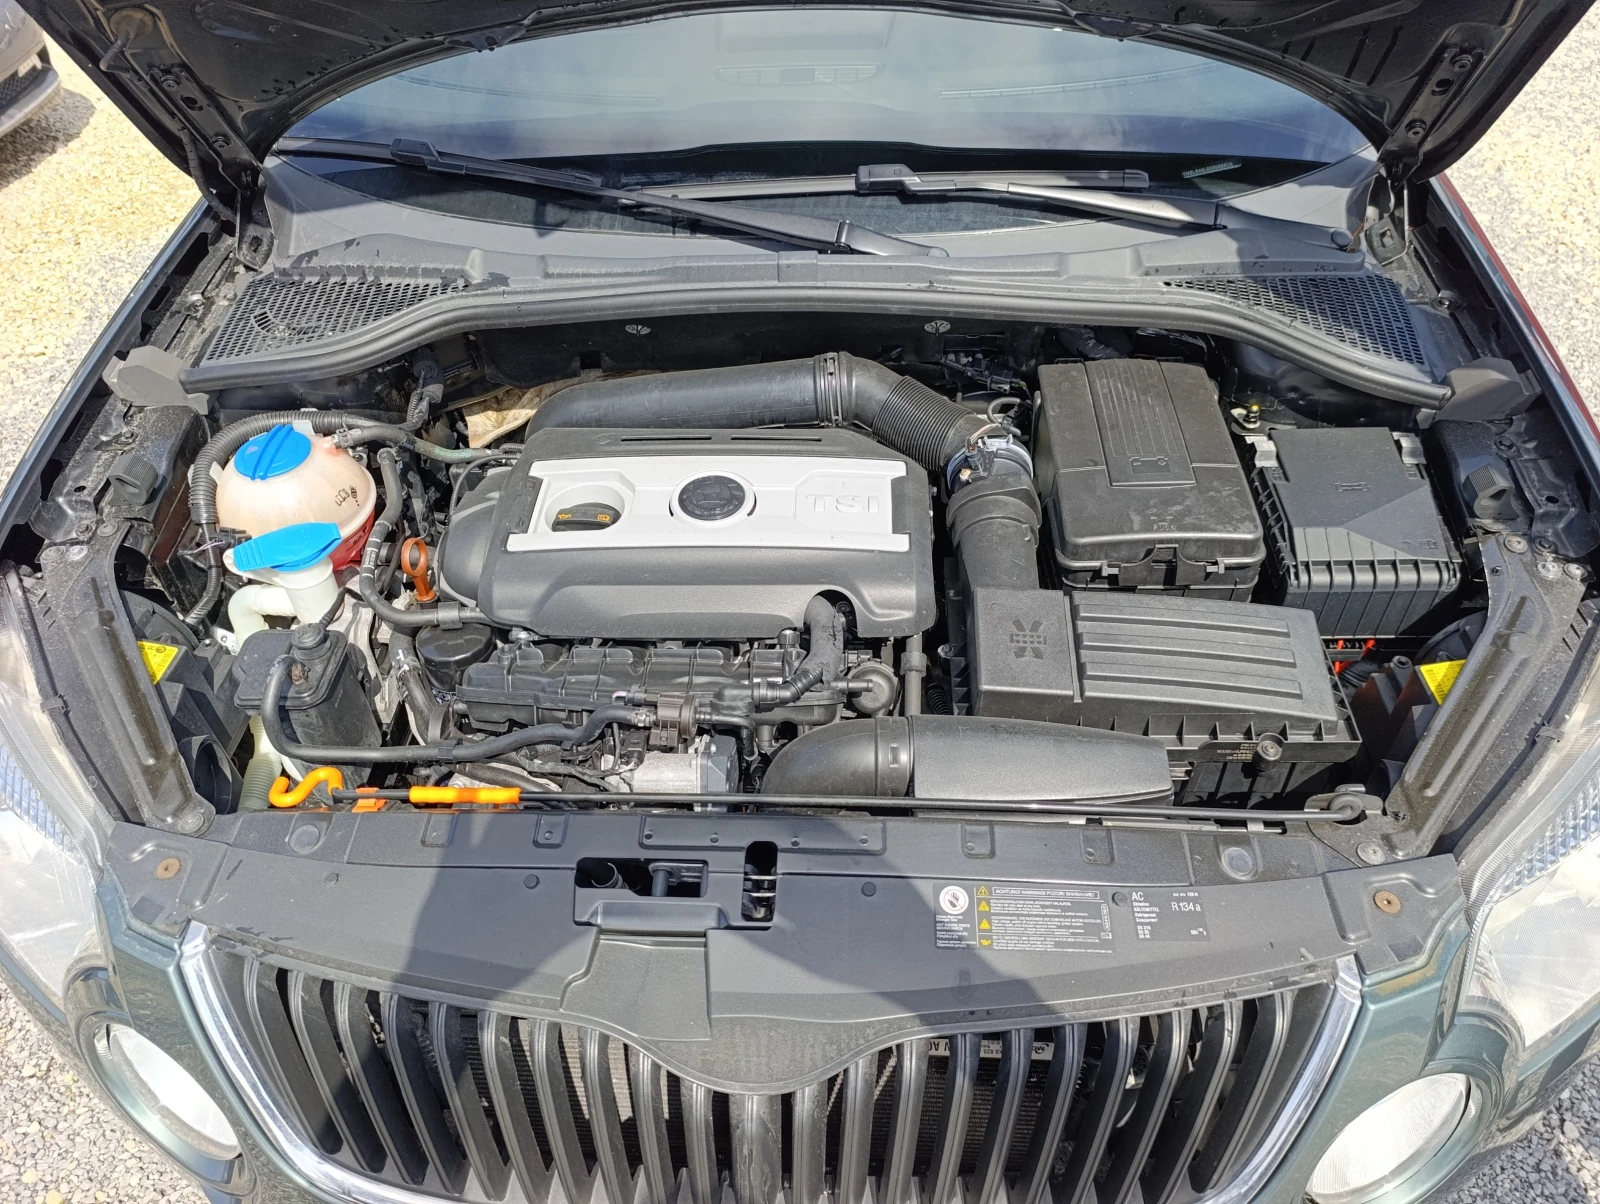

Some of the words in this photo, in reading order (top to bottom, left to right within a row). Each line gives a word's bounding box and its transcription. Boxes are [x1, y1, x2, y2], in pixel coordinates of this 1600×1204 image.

[806, 494, 880, 514] TSI
[1132, 892, 1144, 901] AC
[1171, 902, 1179, 911] R
[1179, 902, 1194, 912] 134
